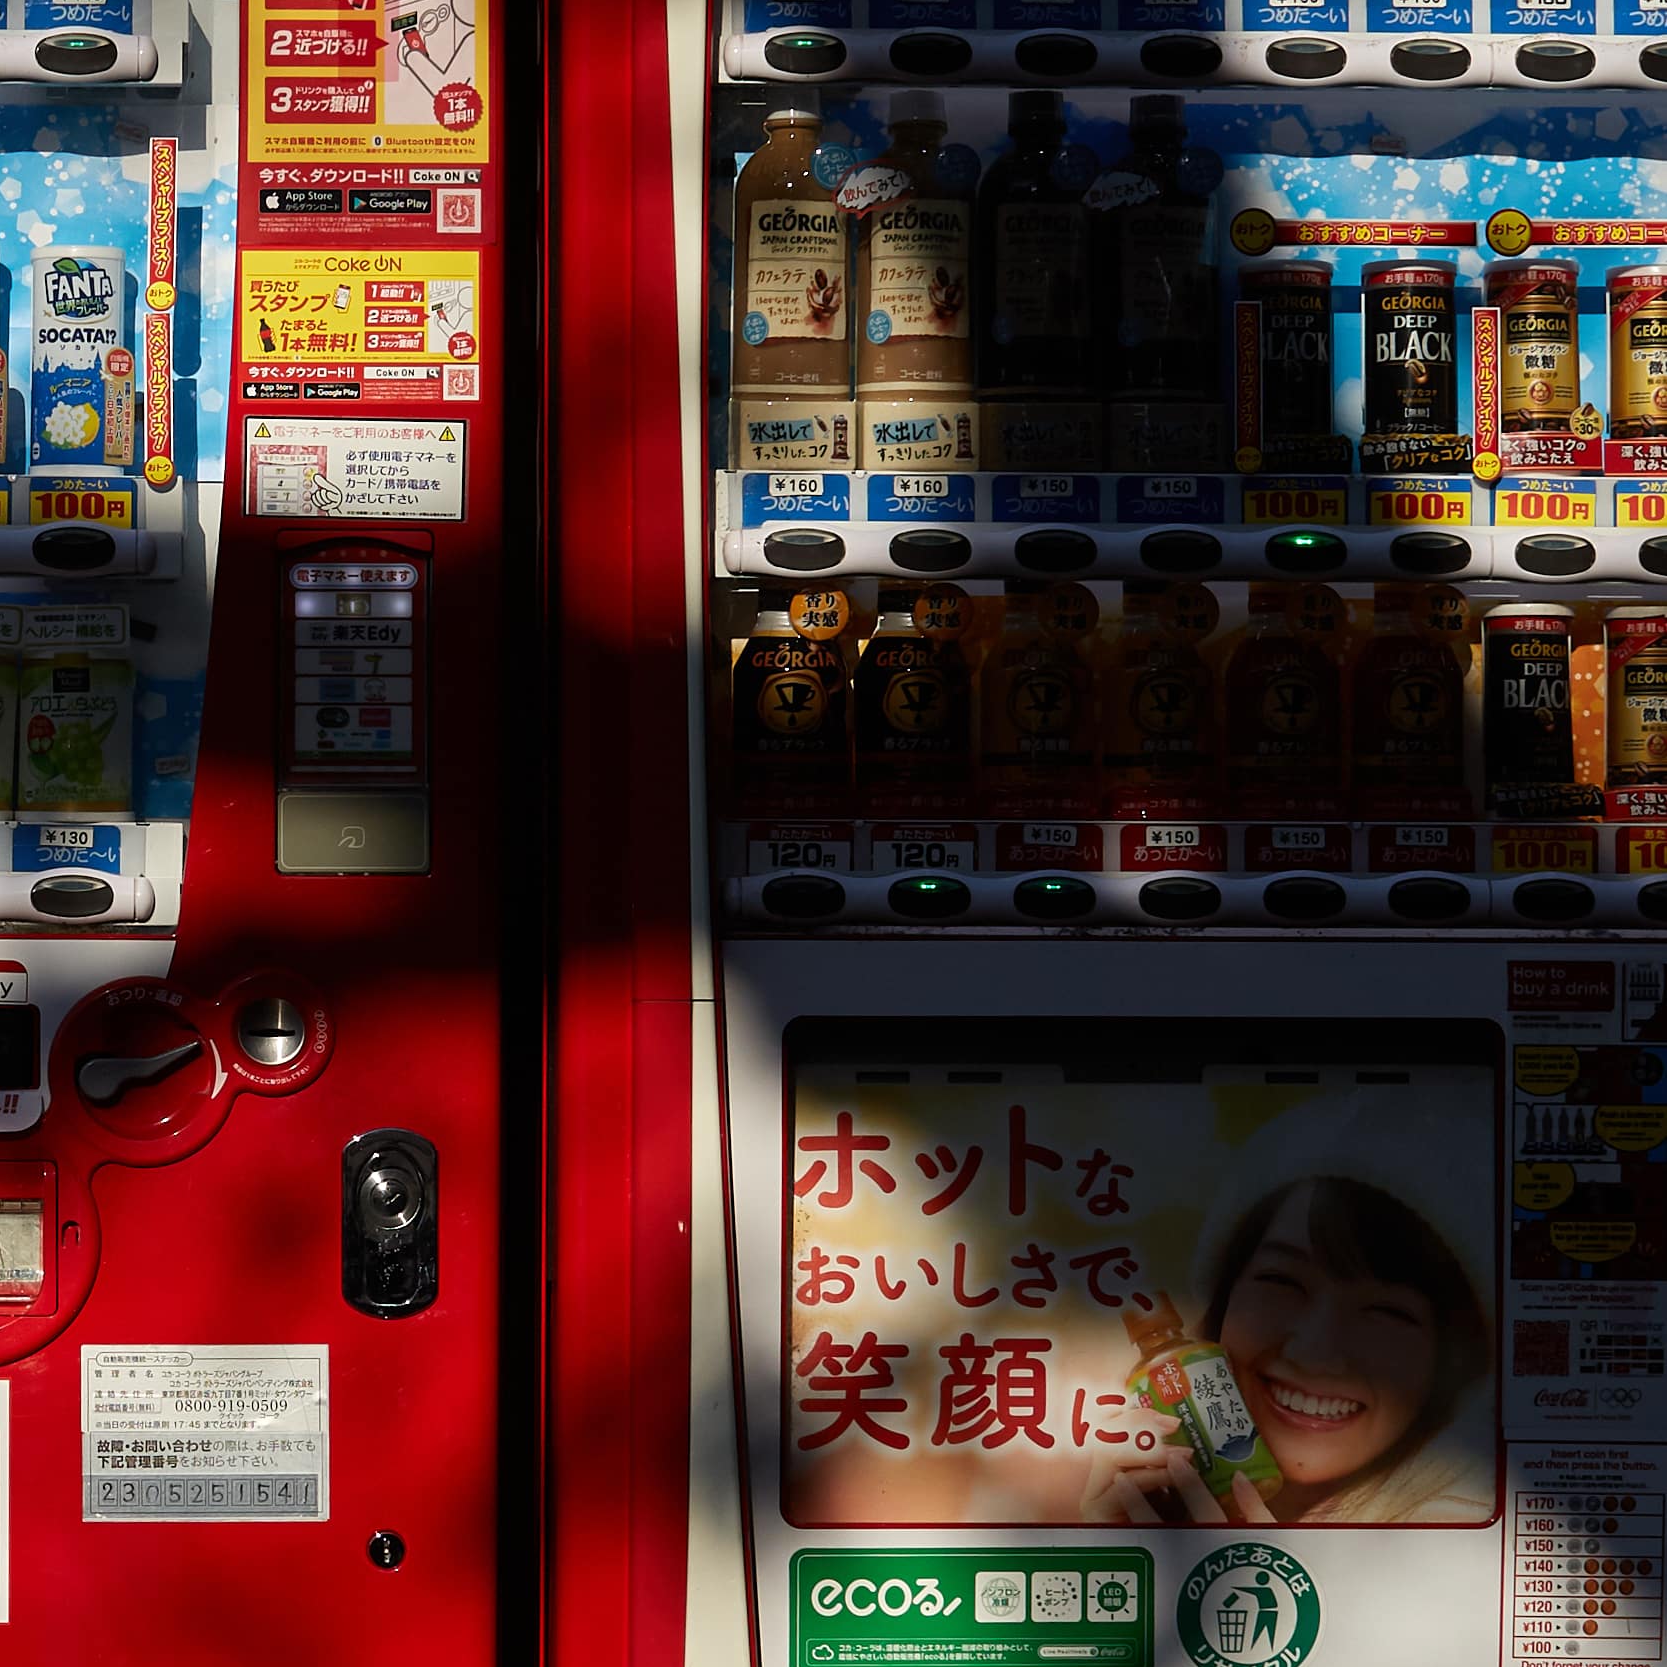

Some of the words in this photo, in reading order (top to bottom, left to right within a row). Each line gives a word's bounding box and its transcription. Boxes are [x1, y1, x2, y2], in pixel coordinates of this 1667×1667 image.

[294, 39, 367, 56] 近づける!!
[259, 169, 404, 184] 今すぐ、ダウンロード!!
[285, 191, 306, 201] App
[310, 191, 333, 200] Store
[369, 198, 405, 210] Google
[406, 198, 428, 210] Play
[1299, 226, 1446, 242] おすすめコーナー
[44, 269, 115, 301] FANTA
[249, 280, 299, 293] 買うたび
[248, 294, 332, 313] スタンプ
[1382, 290, 1446, 311] GEORGIA
[1393, 315, 1437, 328] DEEP
[1375, 332, 1453, 363] BLACK
[1524, 354, 1556, 370] 微糖
[749, 421, 813, 442] 水出しで
[1510, 452, 1574, 465] 飲みごたえ
[1502, 493, 1589, 520] 100円
[805, 592, 837, 609] 香り
[802, 609, 839, 629] 実感
[767, 843, 835, 868] 120円
[794, 1104, 1134, 1216] ホットな
[796, 1243, 1154, 1312] おいしさで、
[796, 1331, 1157, 1452] 笑顔に。
[175, 1400, 288, 1412] 0800-919-0509
[1194, 1374, 1231, 1430] 綾鷹
[1187, 1545, 1312, 1600] のんだあとは
